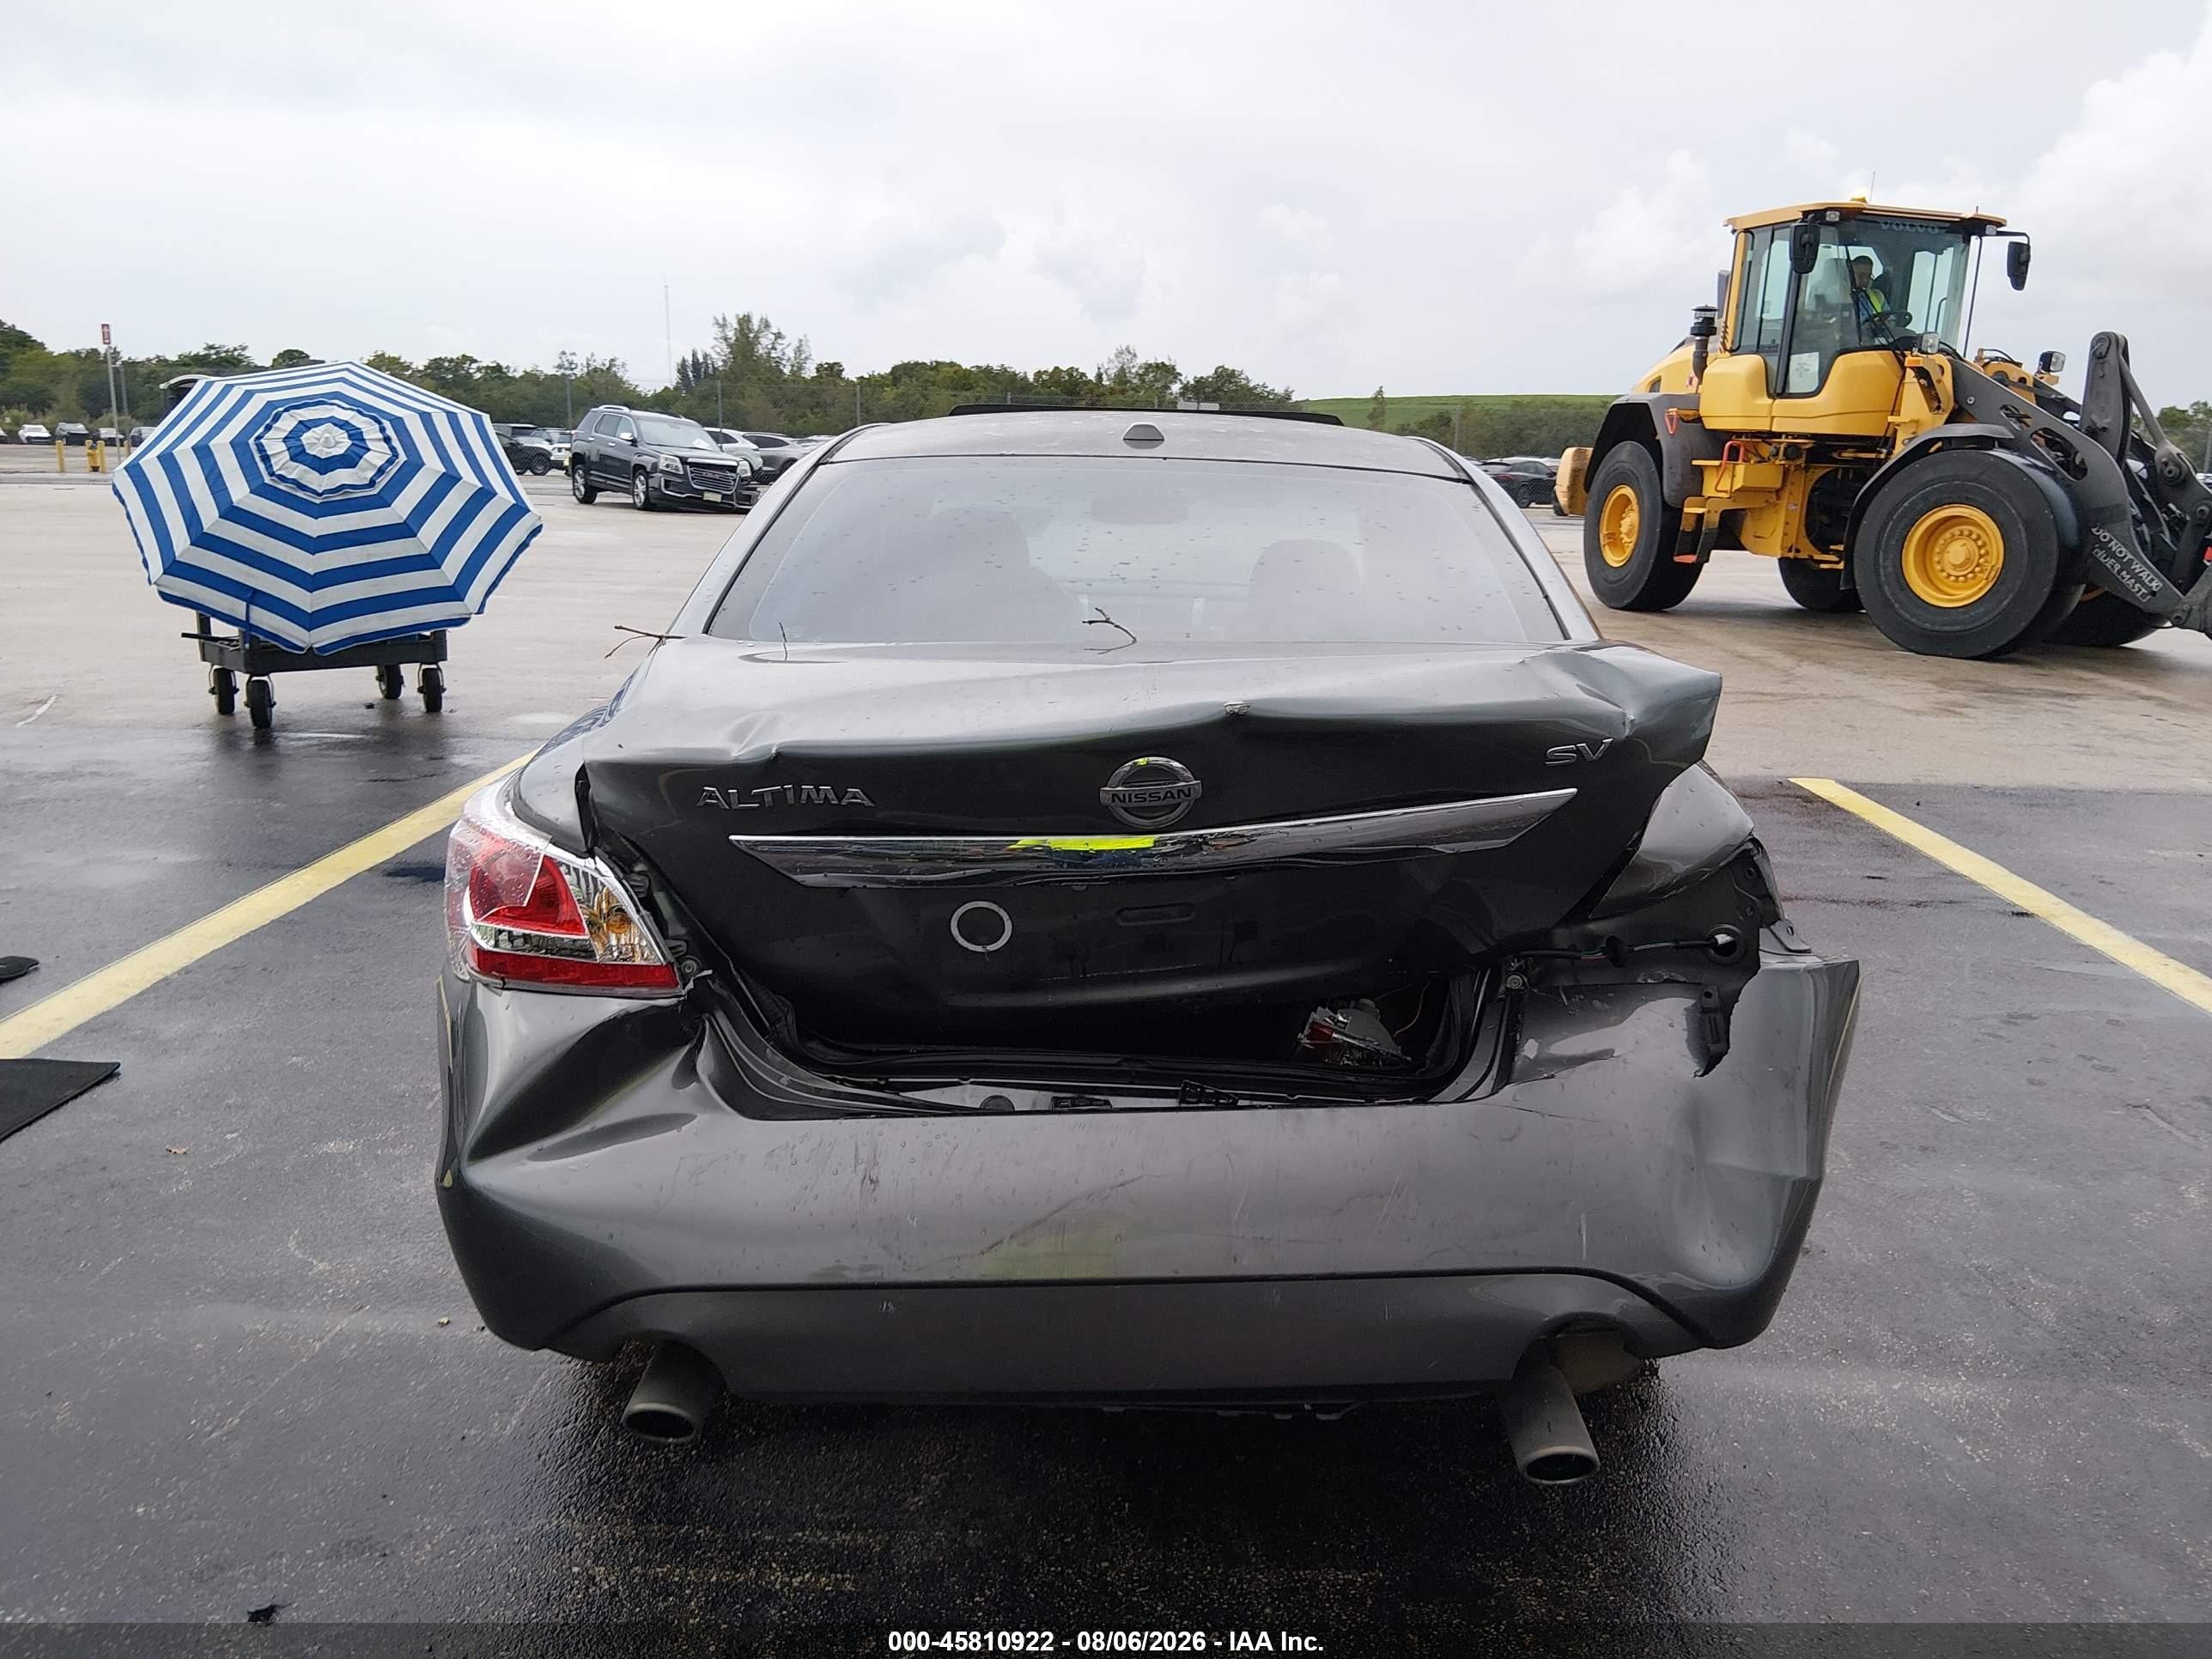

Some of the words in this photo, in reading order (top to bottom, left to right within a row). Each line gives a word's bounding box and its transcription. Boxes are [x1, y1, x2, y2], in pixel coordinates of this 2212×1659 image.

[2107, 538, 2132, 563] NOT
[2130, 560, 2160, 591] WALK
[2118, 570, 2148, 598] MAST
[1546, 738, 1613, 766] SV
[696, 785, 875, 809] ALTIMA
[1111, 787, 1192, 804] NISSAN
